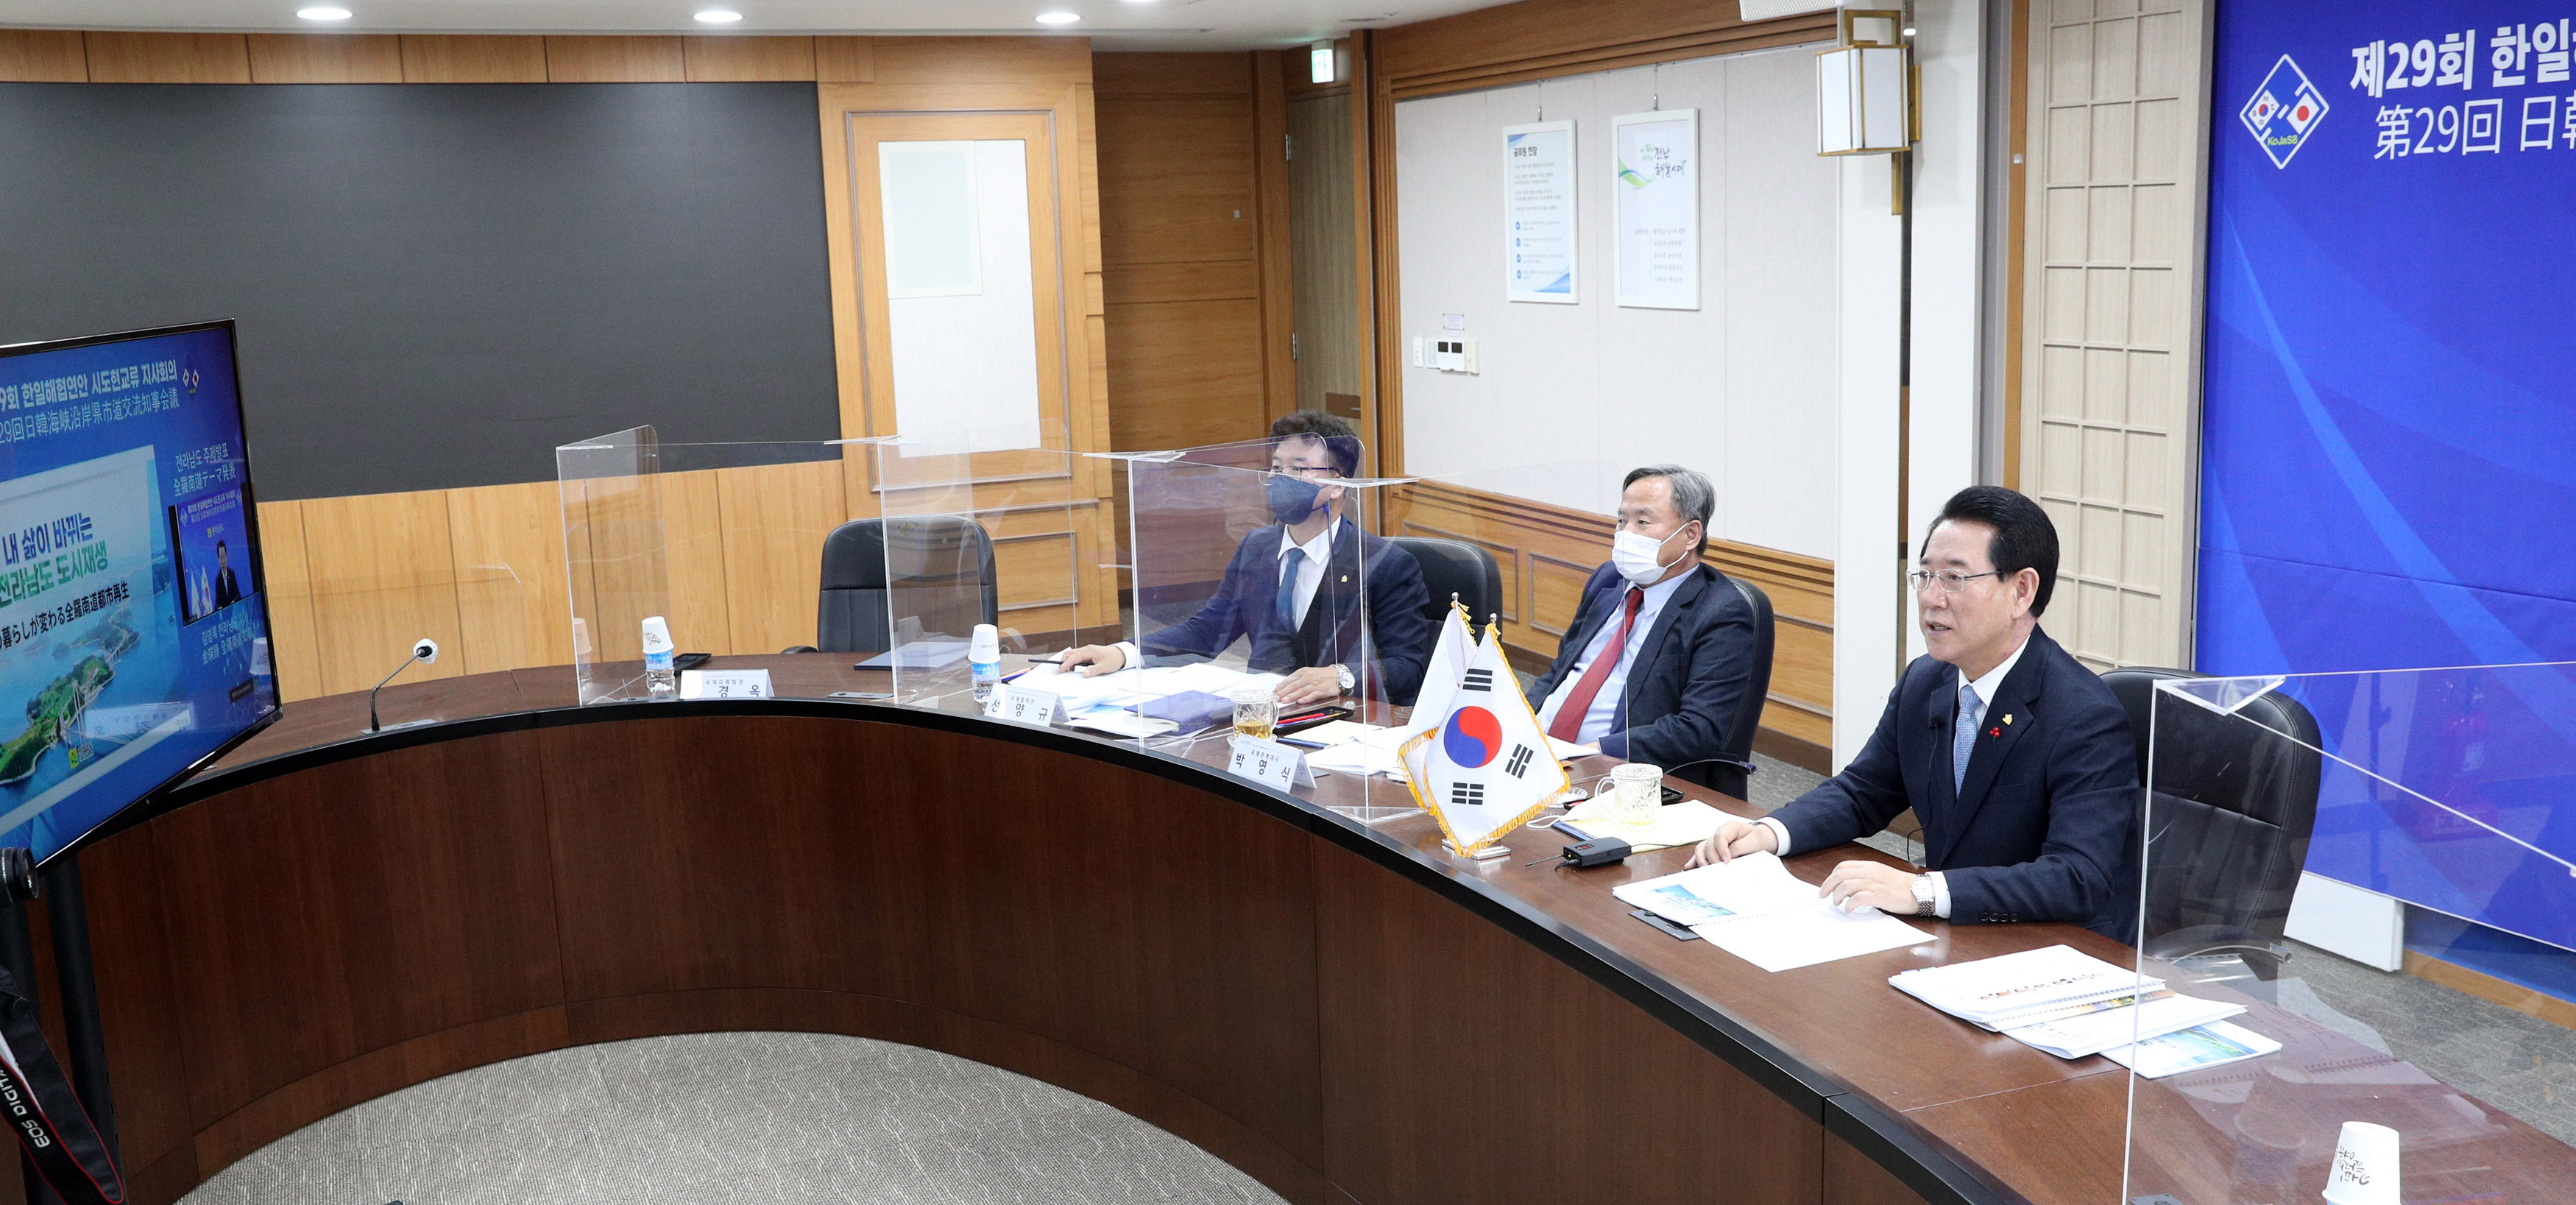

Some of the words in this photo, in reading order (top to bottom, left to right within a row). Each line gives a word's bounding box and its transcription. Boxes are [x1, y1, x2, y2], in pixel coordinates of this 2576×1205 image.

[2350, 29, 2475, 98] 제29회
[2491, 18, 2576, 87] 한일
[2267, 134, 2299, 146] KoJaS8
[2374, 99, 2503, 160] 第29回
[21, 373, 89, 408] 한일해협연안
[91, 365, 141, 395] 시도현교류
[141, 359, 178, 385] 지사회의
[176, 450, 203, 472] 전라남도
[2, 533, 19, 565] 내
[22, 523, 51, 561] 삶이
[52, 512, 93, 550] 바뀌는
[0, 560, 54, 608] 전라남도
[56, 540, 108, 585] 도시재생
[0, 580, 130, 649] 暮らしが変わる全羅南道都市再生
[718, 685, 729, 698] 경
[749, 685, 761, 697] 옥
[991, 699, 1001, 713] 선
[1016, 703, 1025, 717] 양
[1038, 707, 1048, 721] 규
[1236, 752, 1245, 768] 박
[1259, 760, 1267, 776] 영
[1281, 766, 1291, 782] 식
[0, 1067, 27, 1116] DIGIT
[21, 1120, 50, 1148] EOS
